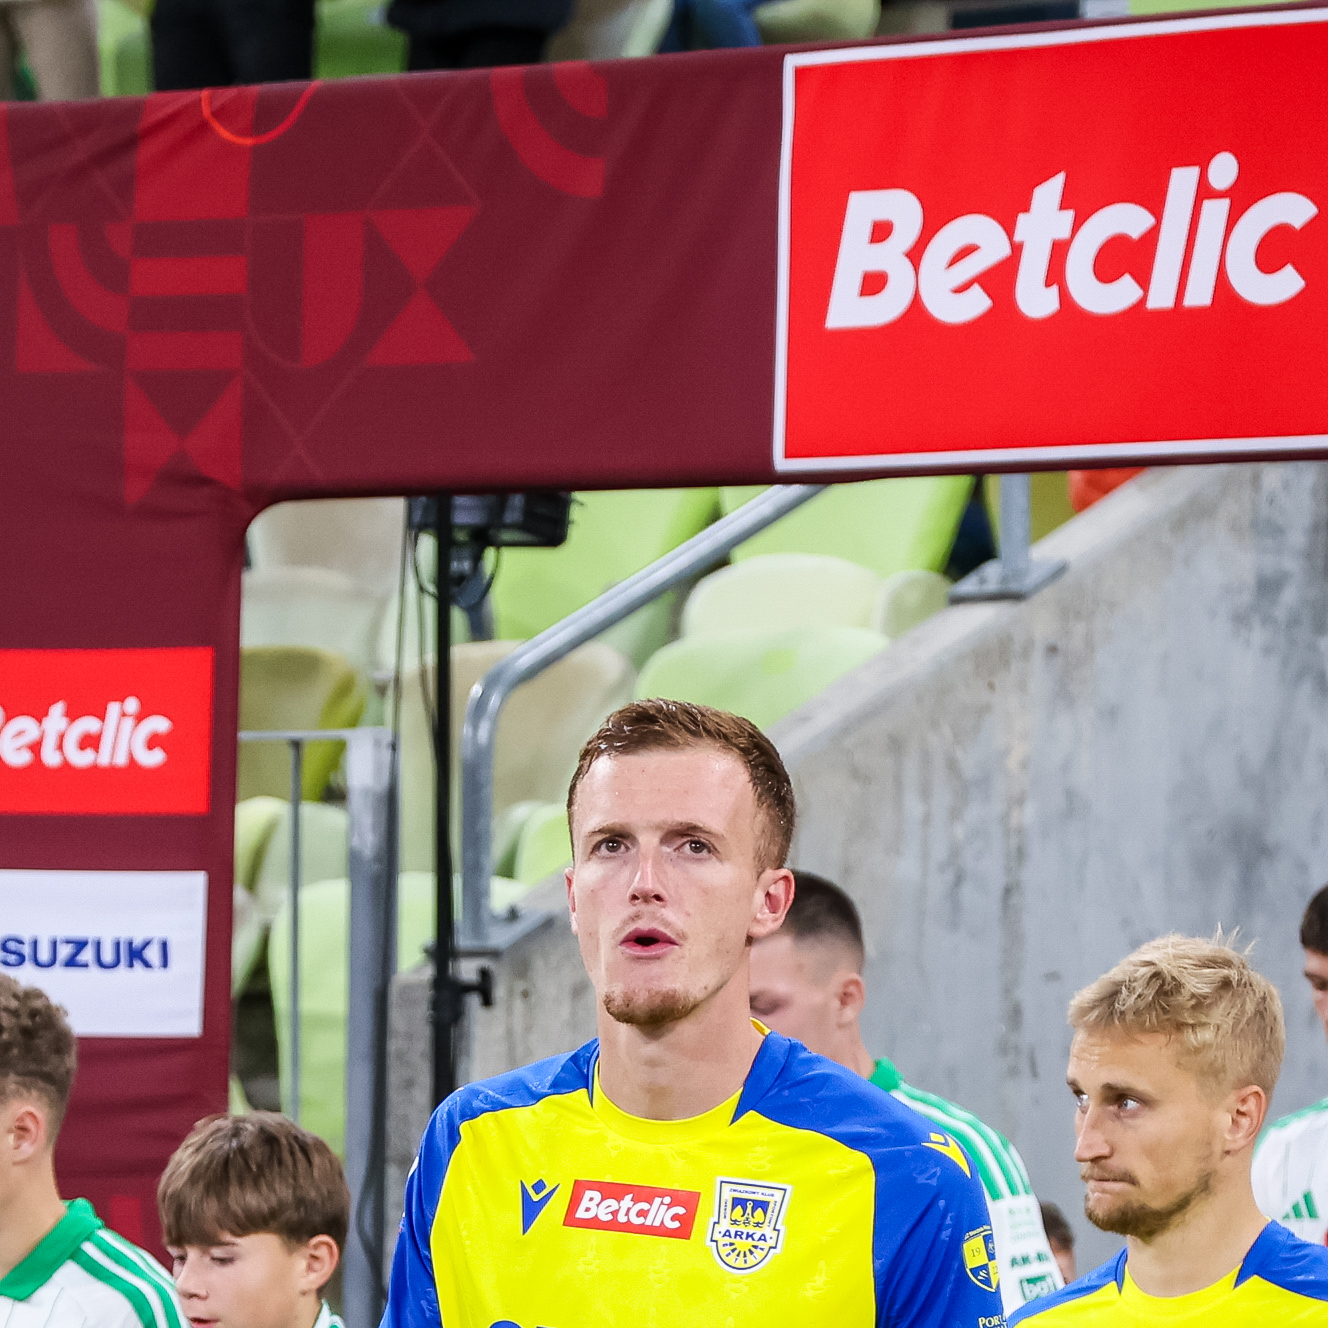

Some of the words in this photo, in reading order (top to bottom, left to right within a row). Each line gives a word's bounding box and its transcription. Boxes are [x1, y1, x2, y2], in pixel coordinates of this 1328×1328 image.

[824, 150, 1320, 331] Betclic
[574, 1189, 688, 1230] Betclic
[722, 1229, 768, 1243] ARKA
